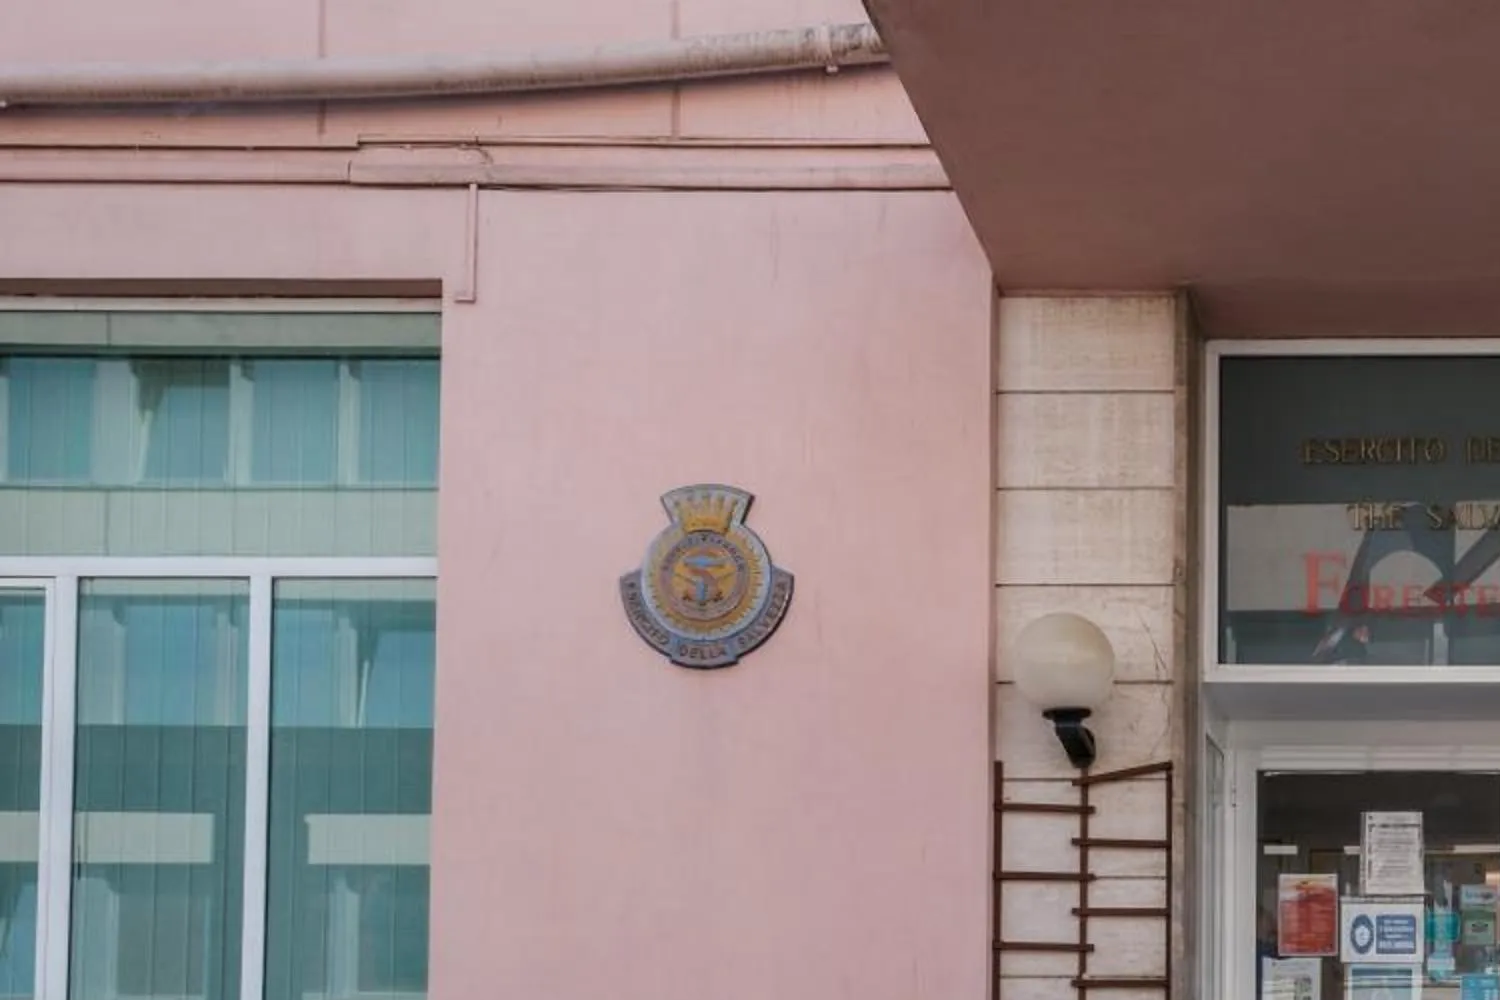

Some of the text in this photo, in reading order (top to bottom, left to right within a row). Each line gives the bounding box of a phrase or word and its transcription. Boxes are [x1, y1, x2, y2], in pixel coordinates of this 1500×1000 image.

[1303, 436, 1446, 465] ESERCITO
[1347, 503, 1402, 530] THE
[679, 644, 727, 659] DELLA
